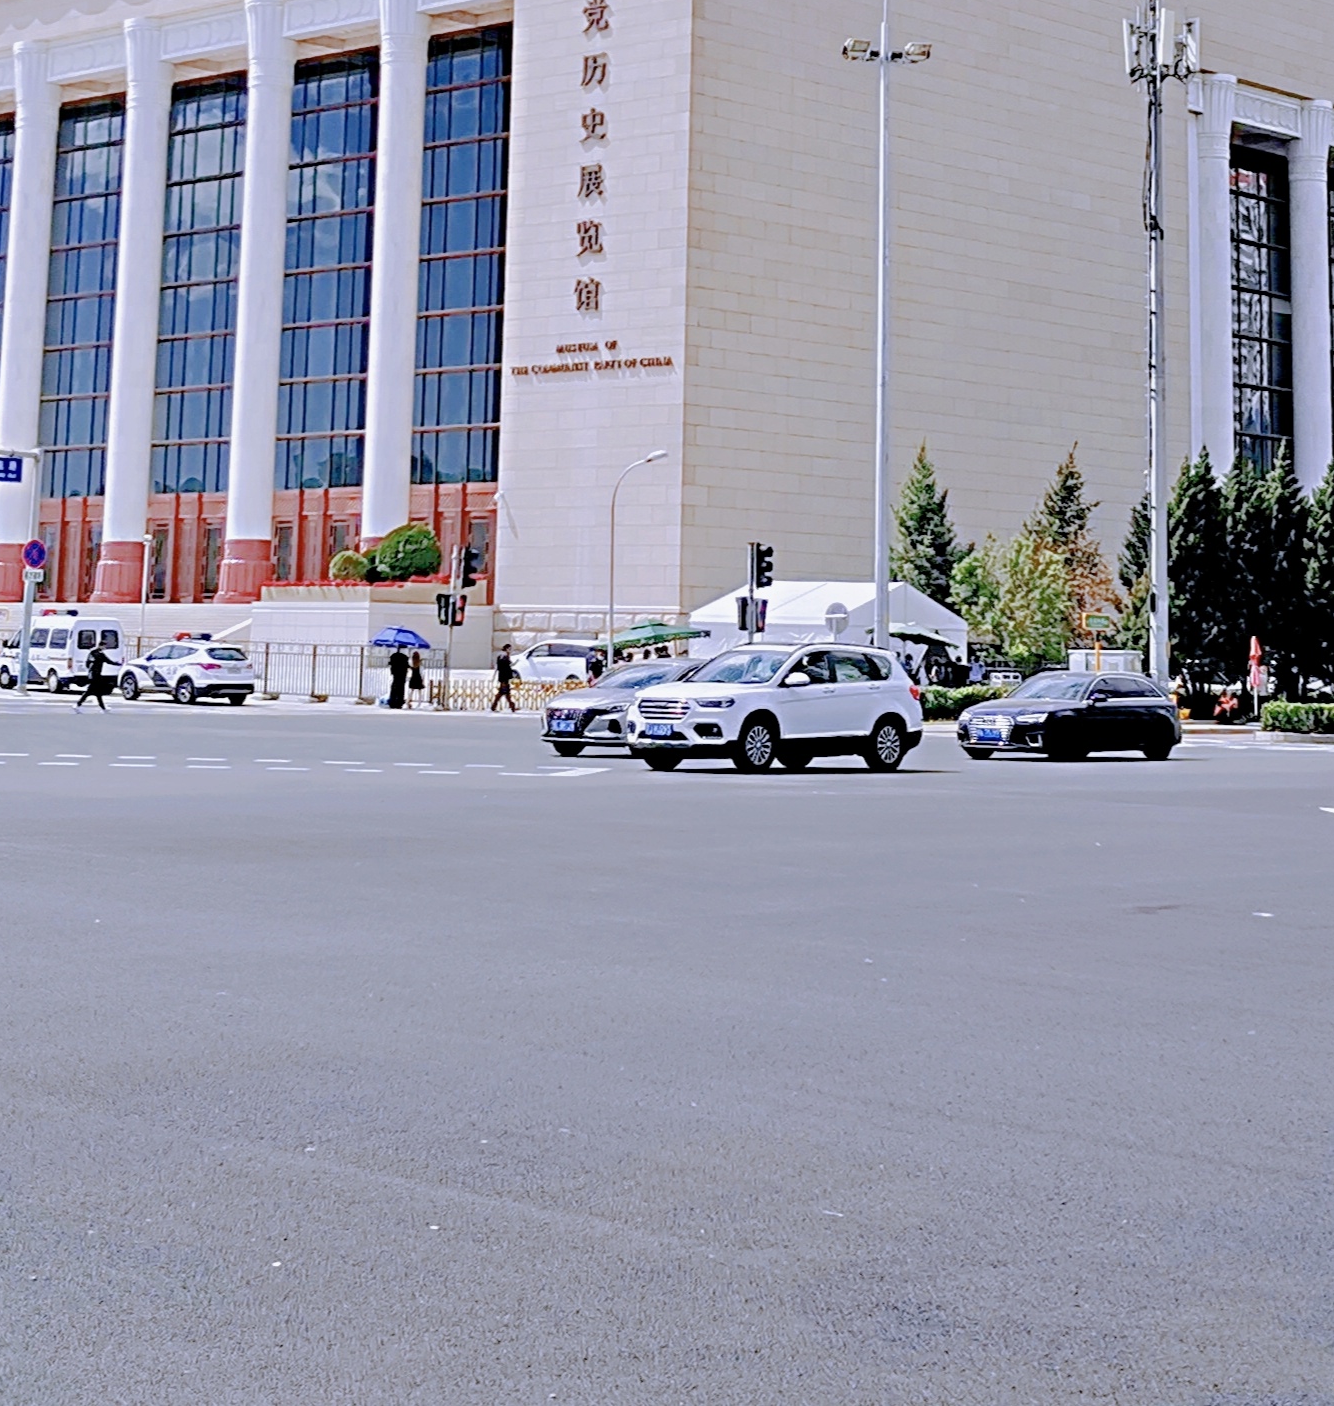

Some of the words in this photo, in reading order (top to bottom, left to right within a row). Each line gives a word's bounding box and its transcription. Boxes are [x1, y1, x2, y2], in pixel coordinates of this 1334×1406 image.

[556, 342, 599, 354] MUSEUM
[605, 340, 618, 351] OF
[511, 366, 529, 375] THE
[624, 358, 638, 369] OF
[639, 356, 674, 368] CHINA
